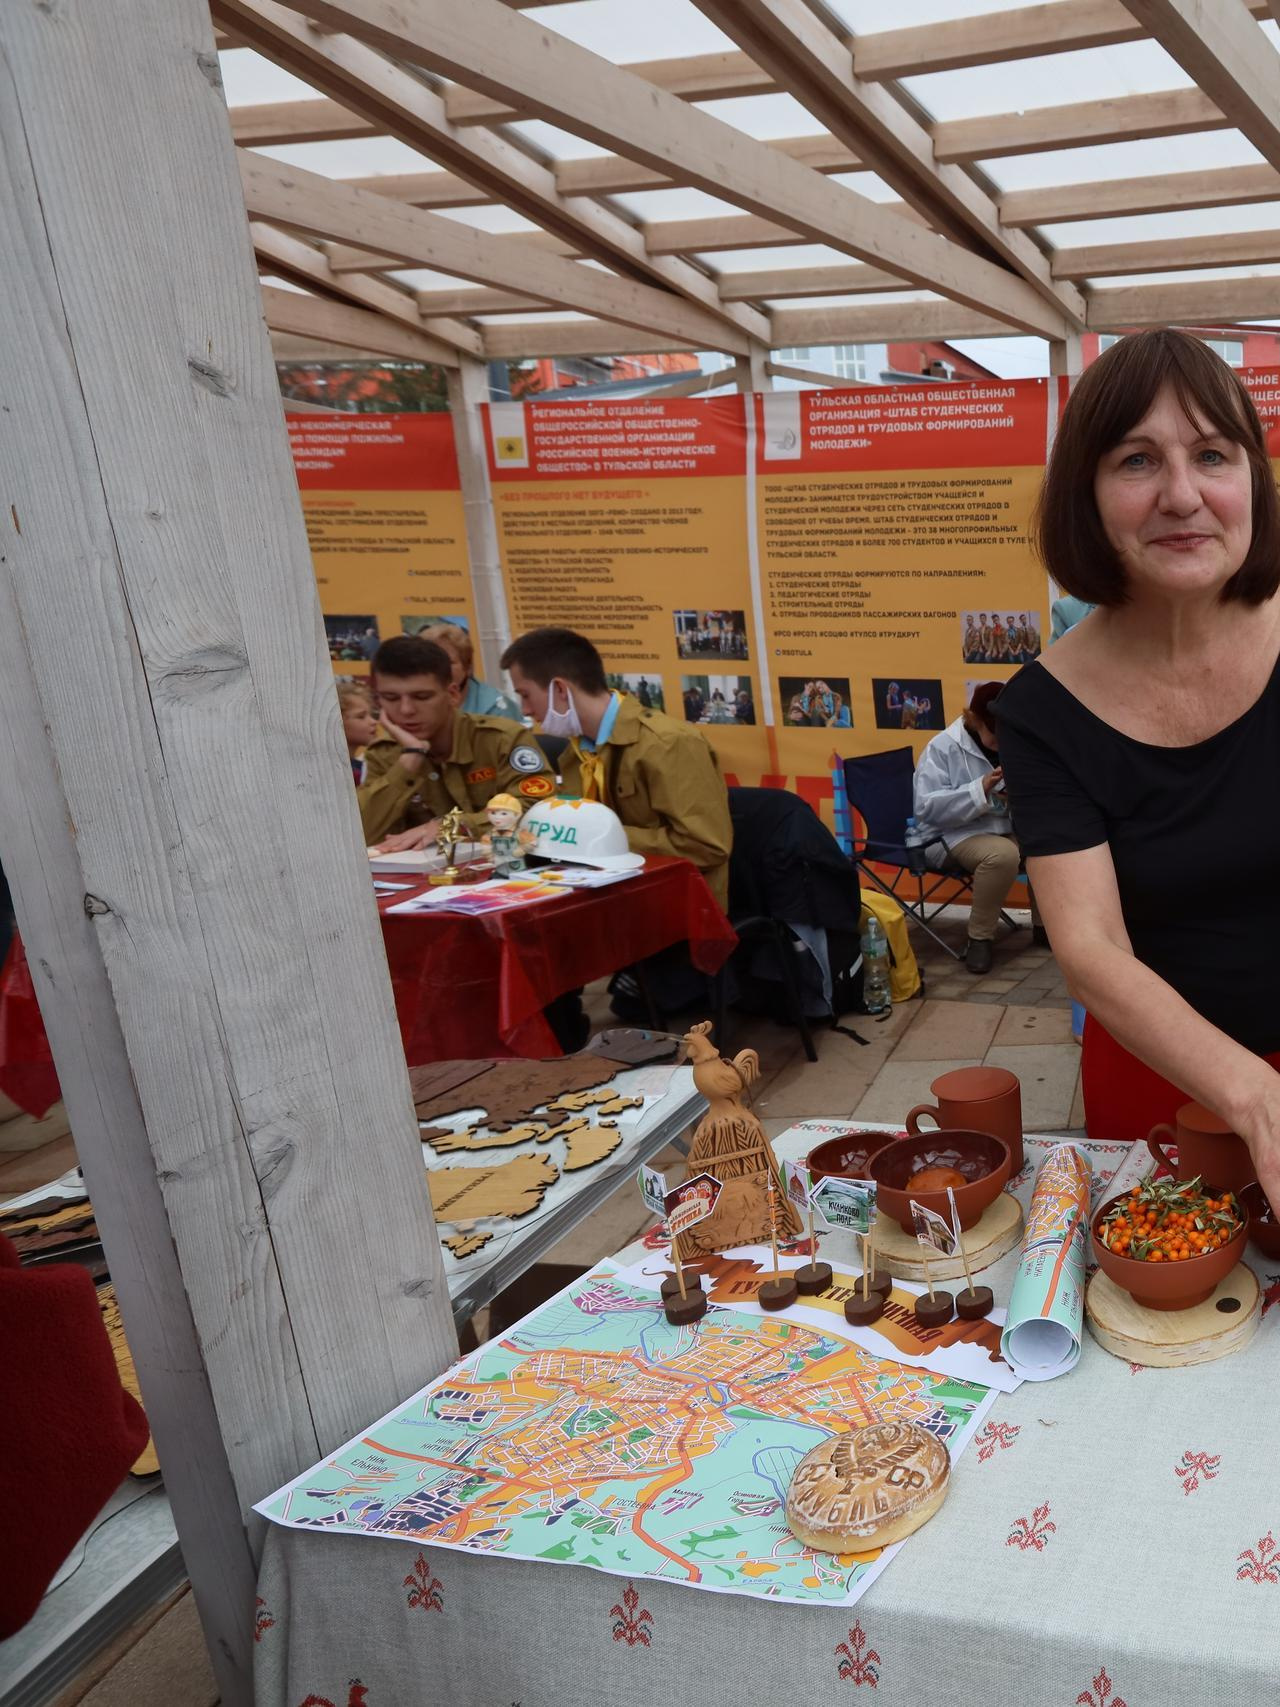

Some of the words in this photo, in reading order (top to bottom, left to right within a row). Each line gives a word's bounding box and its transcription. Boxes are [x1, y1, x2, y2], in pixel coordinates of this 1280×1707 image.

[810, 395, 861, 406] ТУЛЬСКАЯ
[864, 392, 924, 404] ОБЛАСТНАЯ
[927, 388, 1015, 401] ОБЩЕСТВЕННАЯ
[533, 407, 605, 417] РЕГИОНАЛЬНОЕ
[608, 406, 664, 416] ОТДЕЛЕНИЕ
[810, 409, 880, 421] ОРГАНИЗАЦИЯ
[883, 408, 918, 418] «ШТАБ
[921, 404, 1004, 416] СТУДЕНЧЕСКИХ
[534, 420, 622, 431] ОБЩЕРОССИЙСКОЙ
[625, 419, 701, 429] ОБЩЕСТВЕННО-
[810, 424, 854, 436] ОТРЯДОВ
[858, 424, 864, 433] И
[868, 421, 923, 433] ТРУДОВЫХ
[927, 416, 1013, 430] ФОРМИРОВАНИЙ
[535, 433, 624, 445] ГОСУДАРСТВЕННОЙ
[626, 433, 695, 443] ОРГАНИЗАЦИИ
[810, 439, 872, 449] МОЛОДЕЖИ»
[536, 447, 599, 458] «РОССИЙСКОЕ
[601, 445, 716, 457] ВОЕННО-ИСТОРИЧЕСКОЕ
[537, 462, 592, 472] ОБЩЕСТВО»
[594, 462, 600, 471] В
[604, 460, 650, 471] ТУЛЬСКОЙ
[653, 460, 696, 470] ОБЛАСТИ
[528, 820, 578, 845] ТРУД
[828, 1201, 860, 1218] КУЛИКОВО
[836, 1214, 850, 1226] ПОЛЕ
[366, 1454, 386, 1464] НИЖ
[351, 1459, 388, 1472] ЕЛЬКИНО
[673, 1488, 703, 1497] Малевка
[732, 1491, 765, 1499] Осиновая
[796, 1488, 888, 1522] РУБЛЬ
